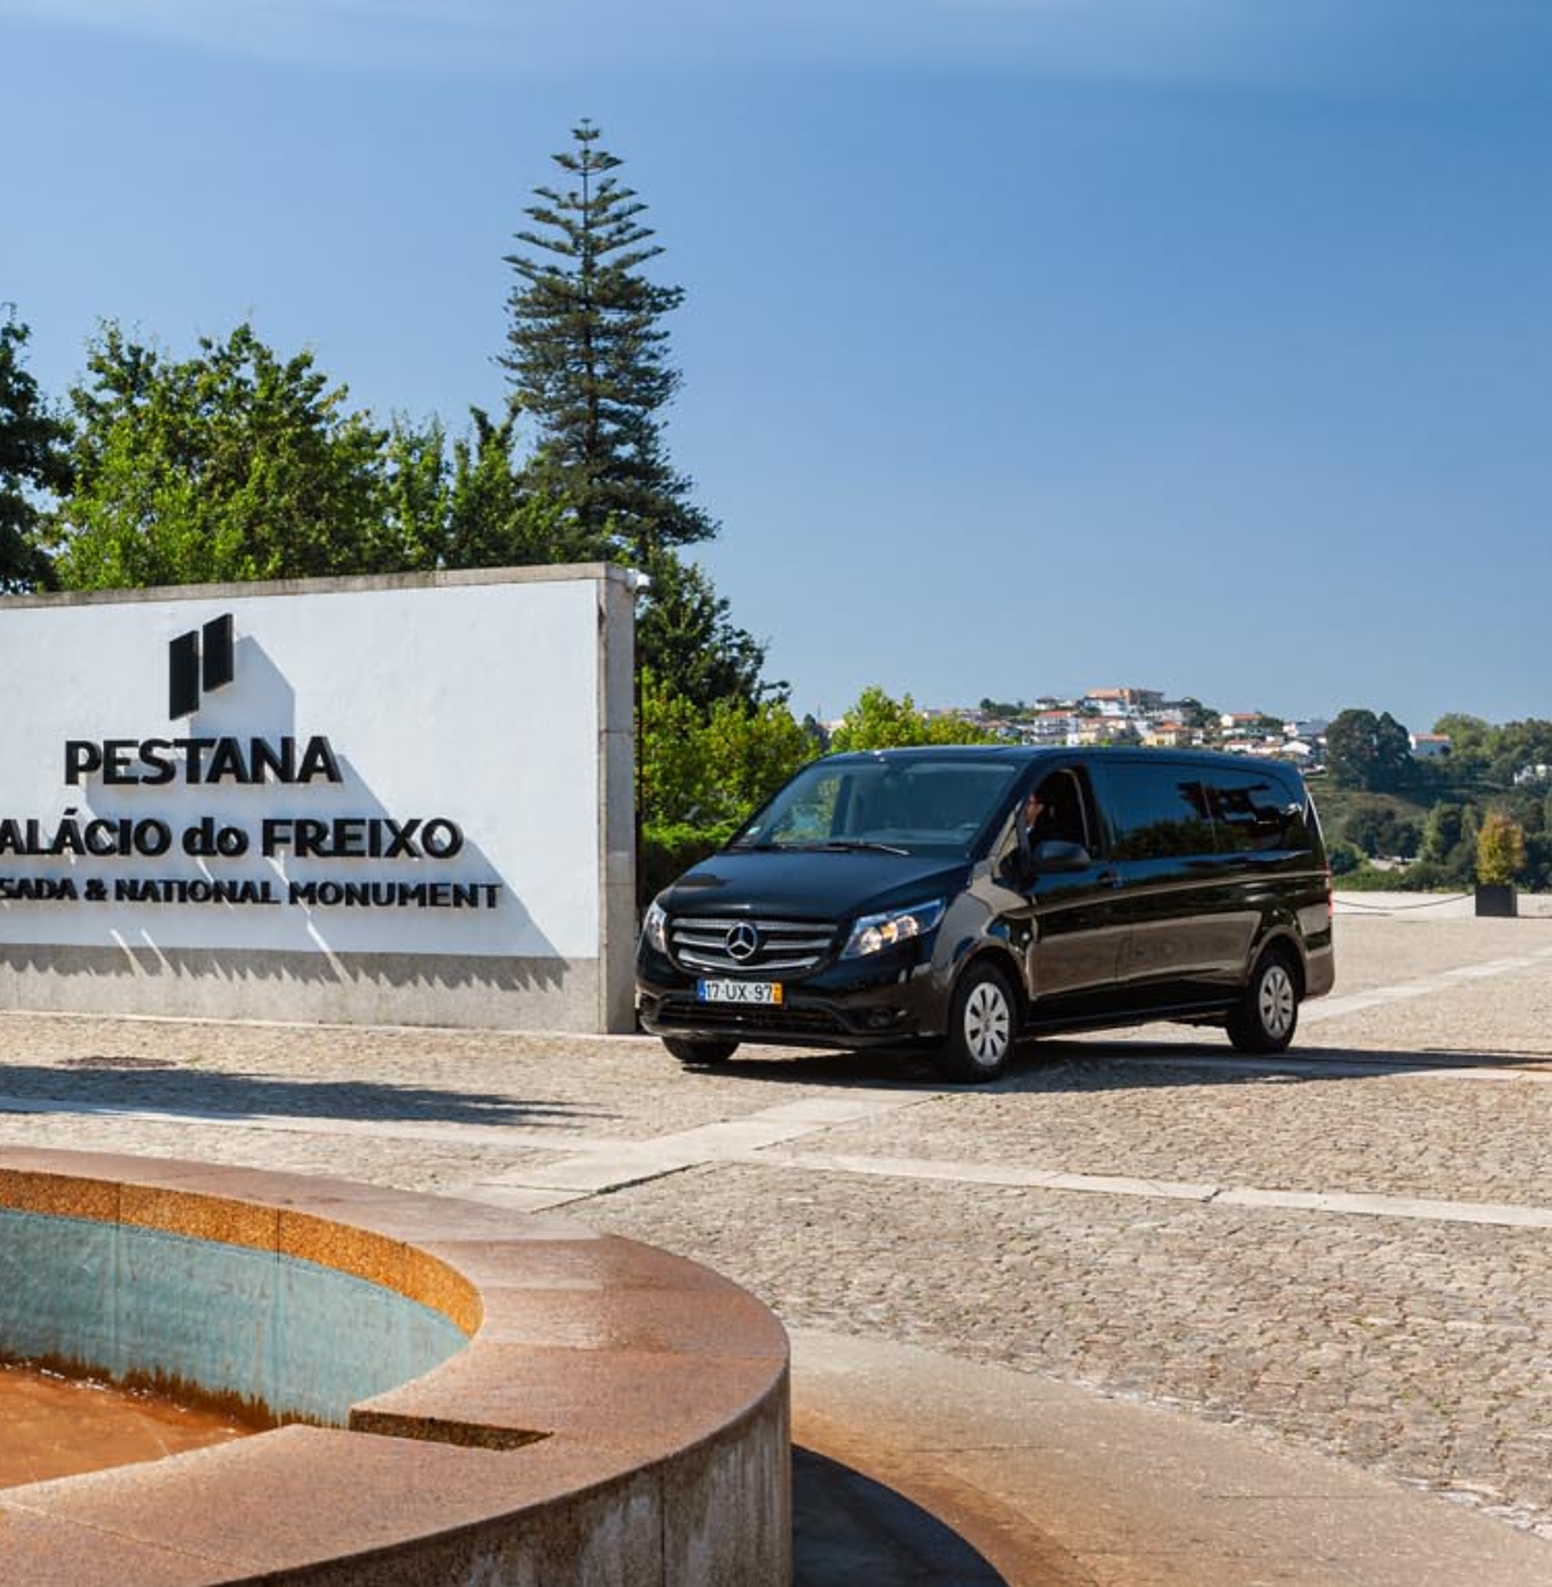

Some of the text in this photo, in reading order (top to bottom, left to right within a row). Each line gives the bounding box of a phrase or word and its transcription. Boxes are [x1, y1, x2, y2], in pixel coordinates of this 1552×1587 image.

[65, 736, 343, 785] PESTANA
[182, 817, 248, 857] do
[262, 818, 464, 859] FREIXO
[84, 879, 107, 901] &
[115, 880, 281, 904] NATIONAL
[289, 882, 503, 908] MONUMENT
